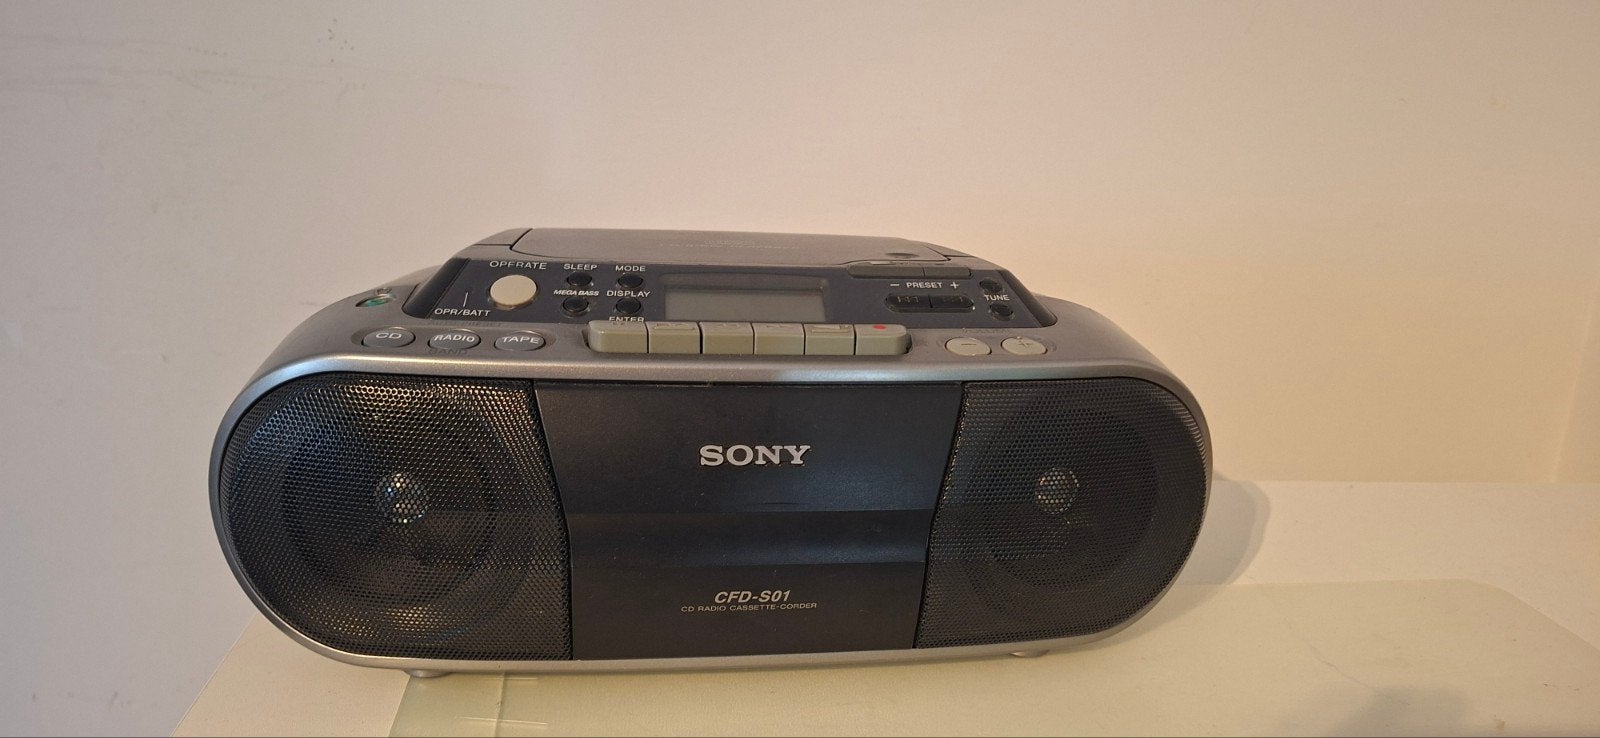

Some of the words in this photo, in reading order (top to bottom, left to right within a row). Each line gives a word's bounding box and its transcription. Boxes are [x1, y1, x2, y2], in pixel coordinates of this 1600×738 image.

[563, 263, 598, 271] SLEEP
[606, 290, 651, 298] DISPLAY
[434, 308, 491, 317] OPR/BATT
[433, 334, 475, 343] RADIO
[500, 336, 540, 345] TAPE
[699, 444, 811, 467] SONY
[714, 590, 791, 604] CFD-S01
[729, 602, 818, 611] CASSETTE-CORDER
